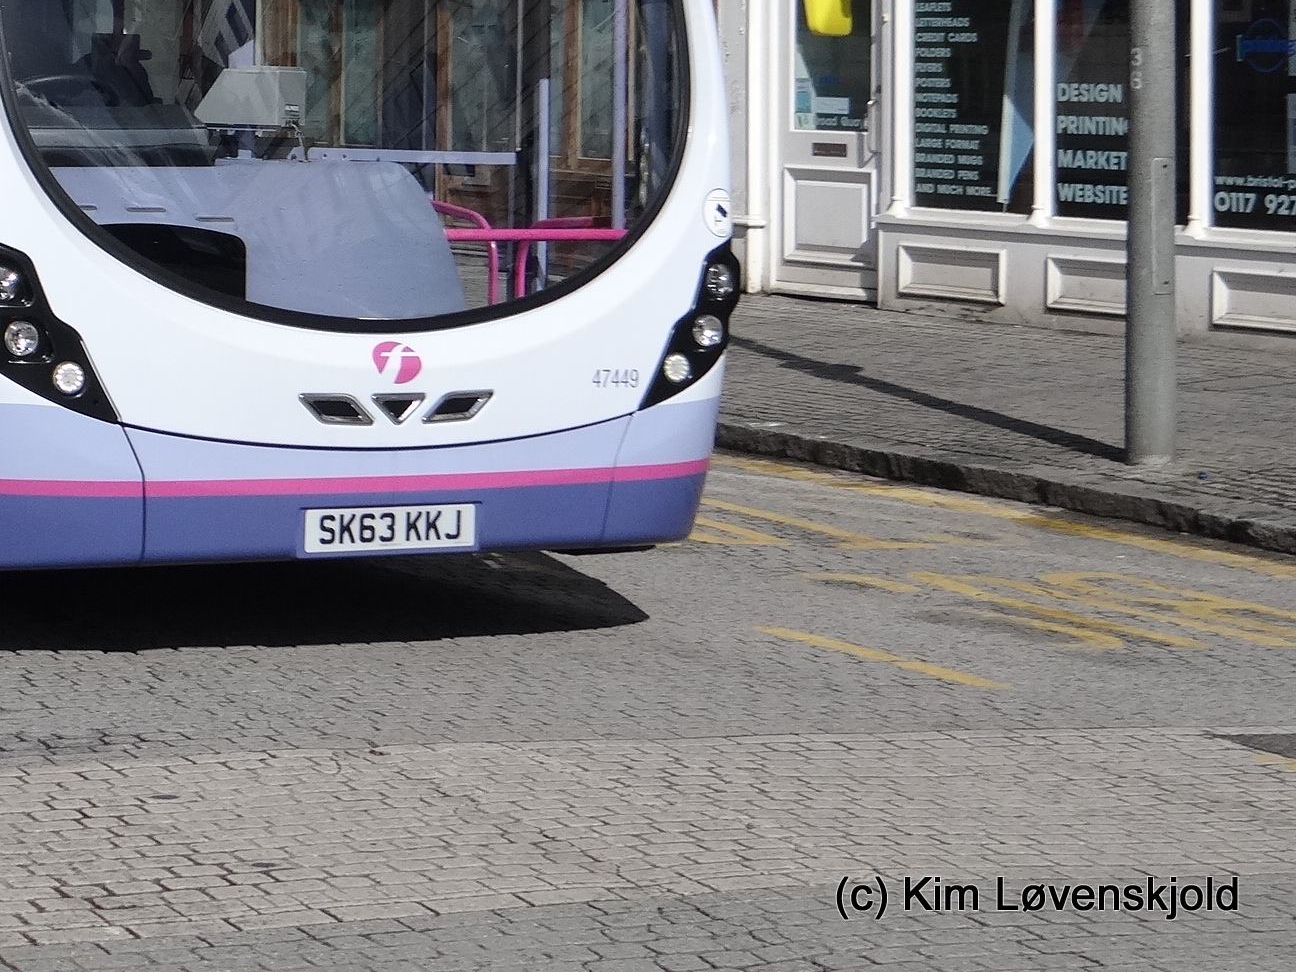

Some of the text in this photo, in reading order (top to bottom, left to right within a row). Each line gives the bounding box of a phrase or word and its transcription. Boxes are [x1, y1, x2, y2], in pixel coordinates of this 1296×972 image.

[1057, 83, 1123, 103] DESIGN
[1057, 115, 1129, 136] PRINTIN
[1057, 149, 1128, 171] MARKET
[916, 183, 935, 193] AND
[1057, 182, 1129, 206] WEBSITE
[1214, 191, 1296, 215] 0117 927
[592, 368, 640, 389] 47449
[318, 509, 463, 546] SK63 KKJ
